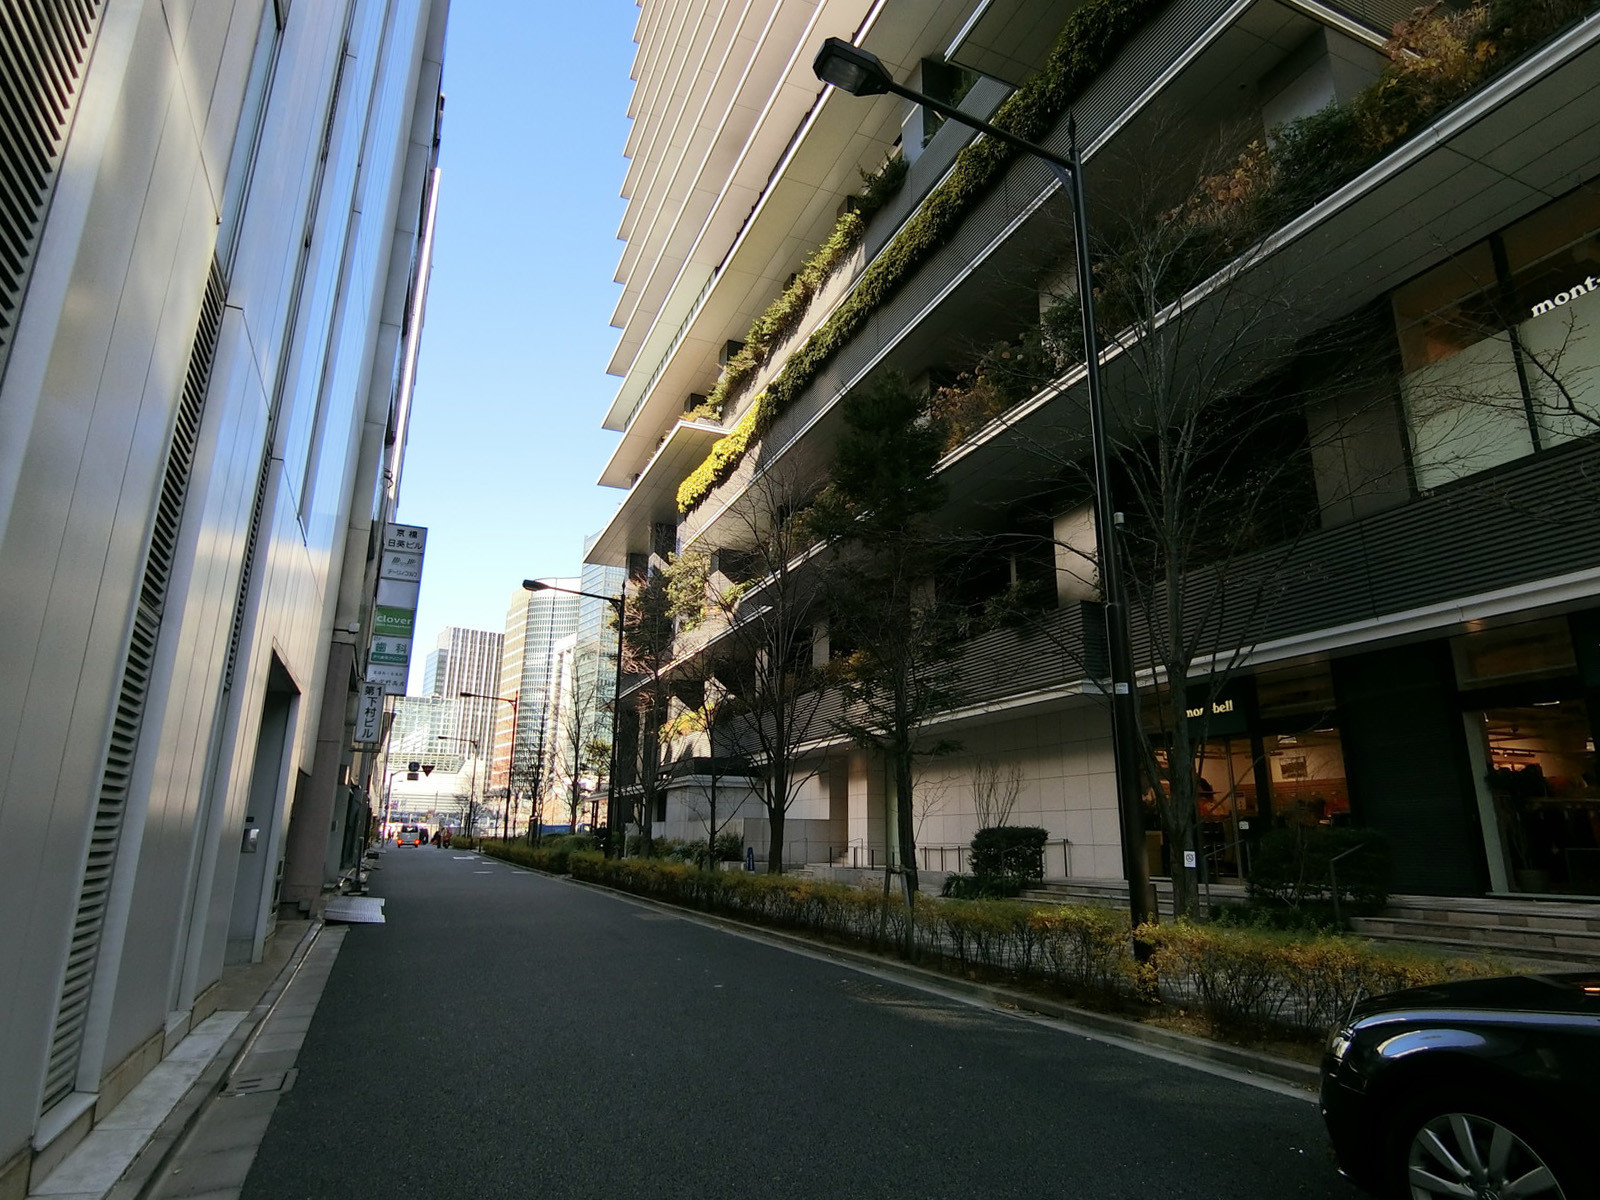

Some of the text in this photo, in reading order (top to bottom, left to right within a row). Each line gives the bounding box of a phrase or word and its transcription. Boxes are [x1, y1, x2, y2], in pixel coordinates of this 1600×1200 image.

[396, 528, 418, 539] 京橋
[388, 538, 423, 550] 日英ビル
[376, 614, 413, 625] clover
[375, 641, 408, 653] 歯科
